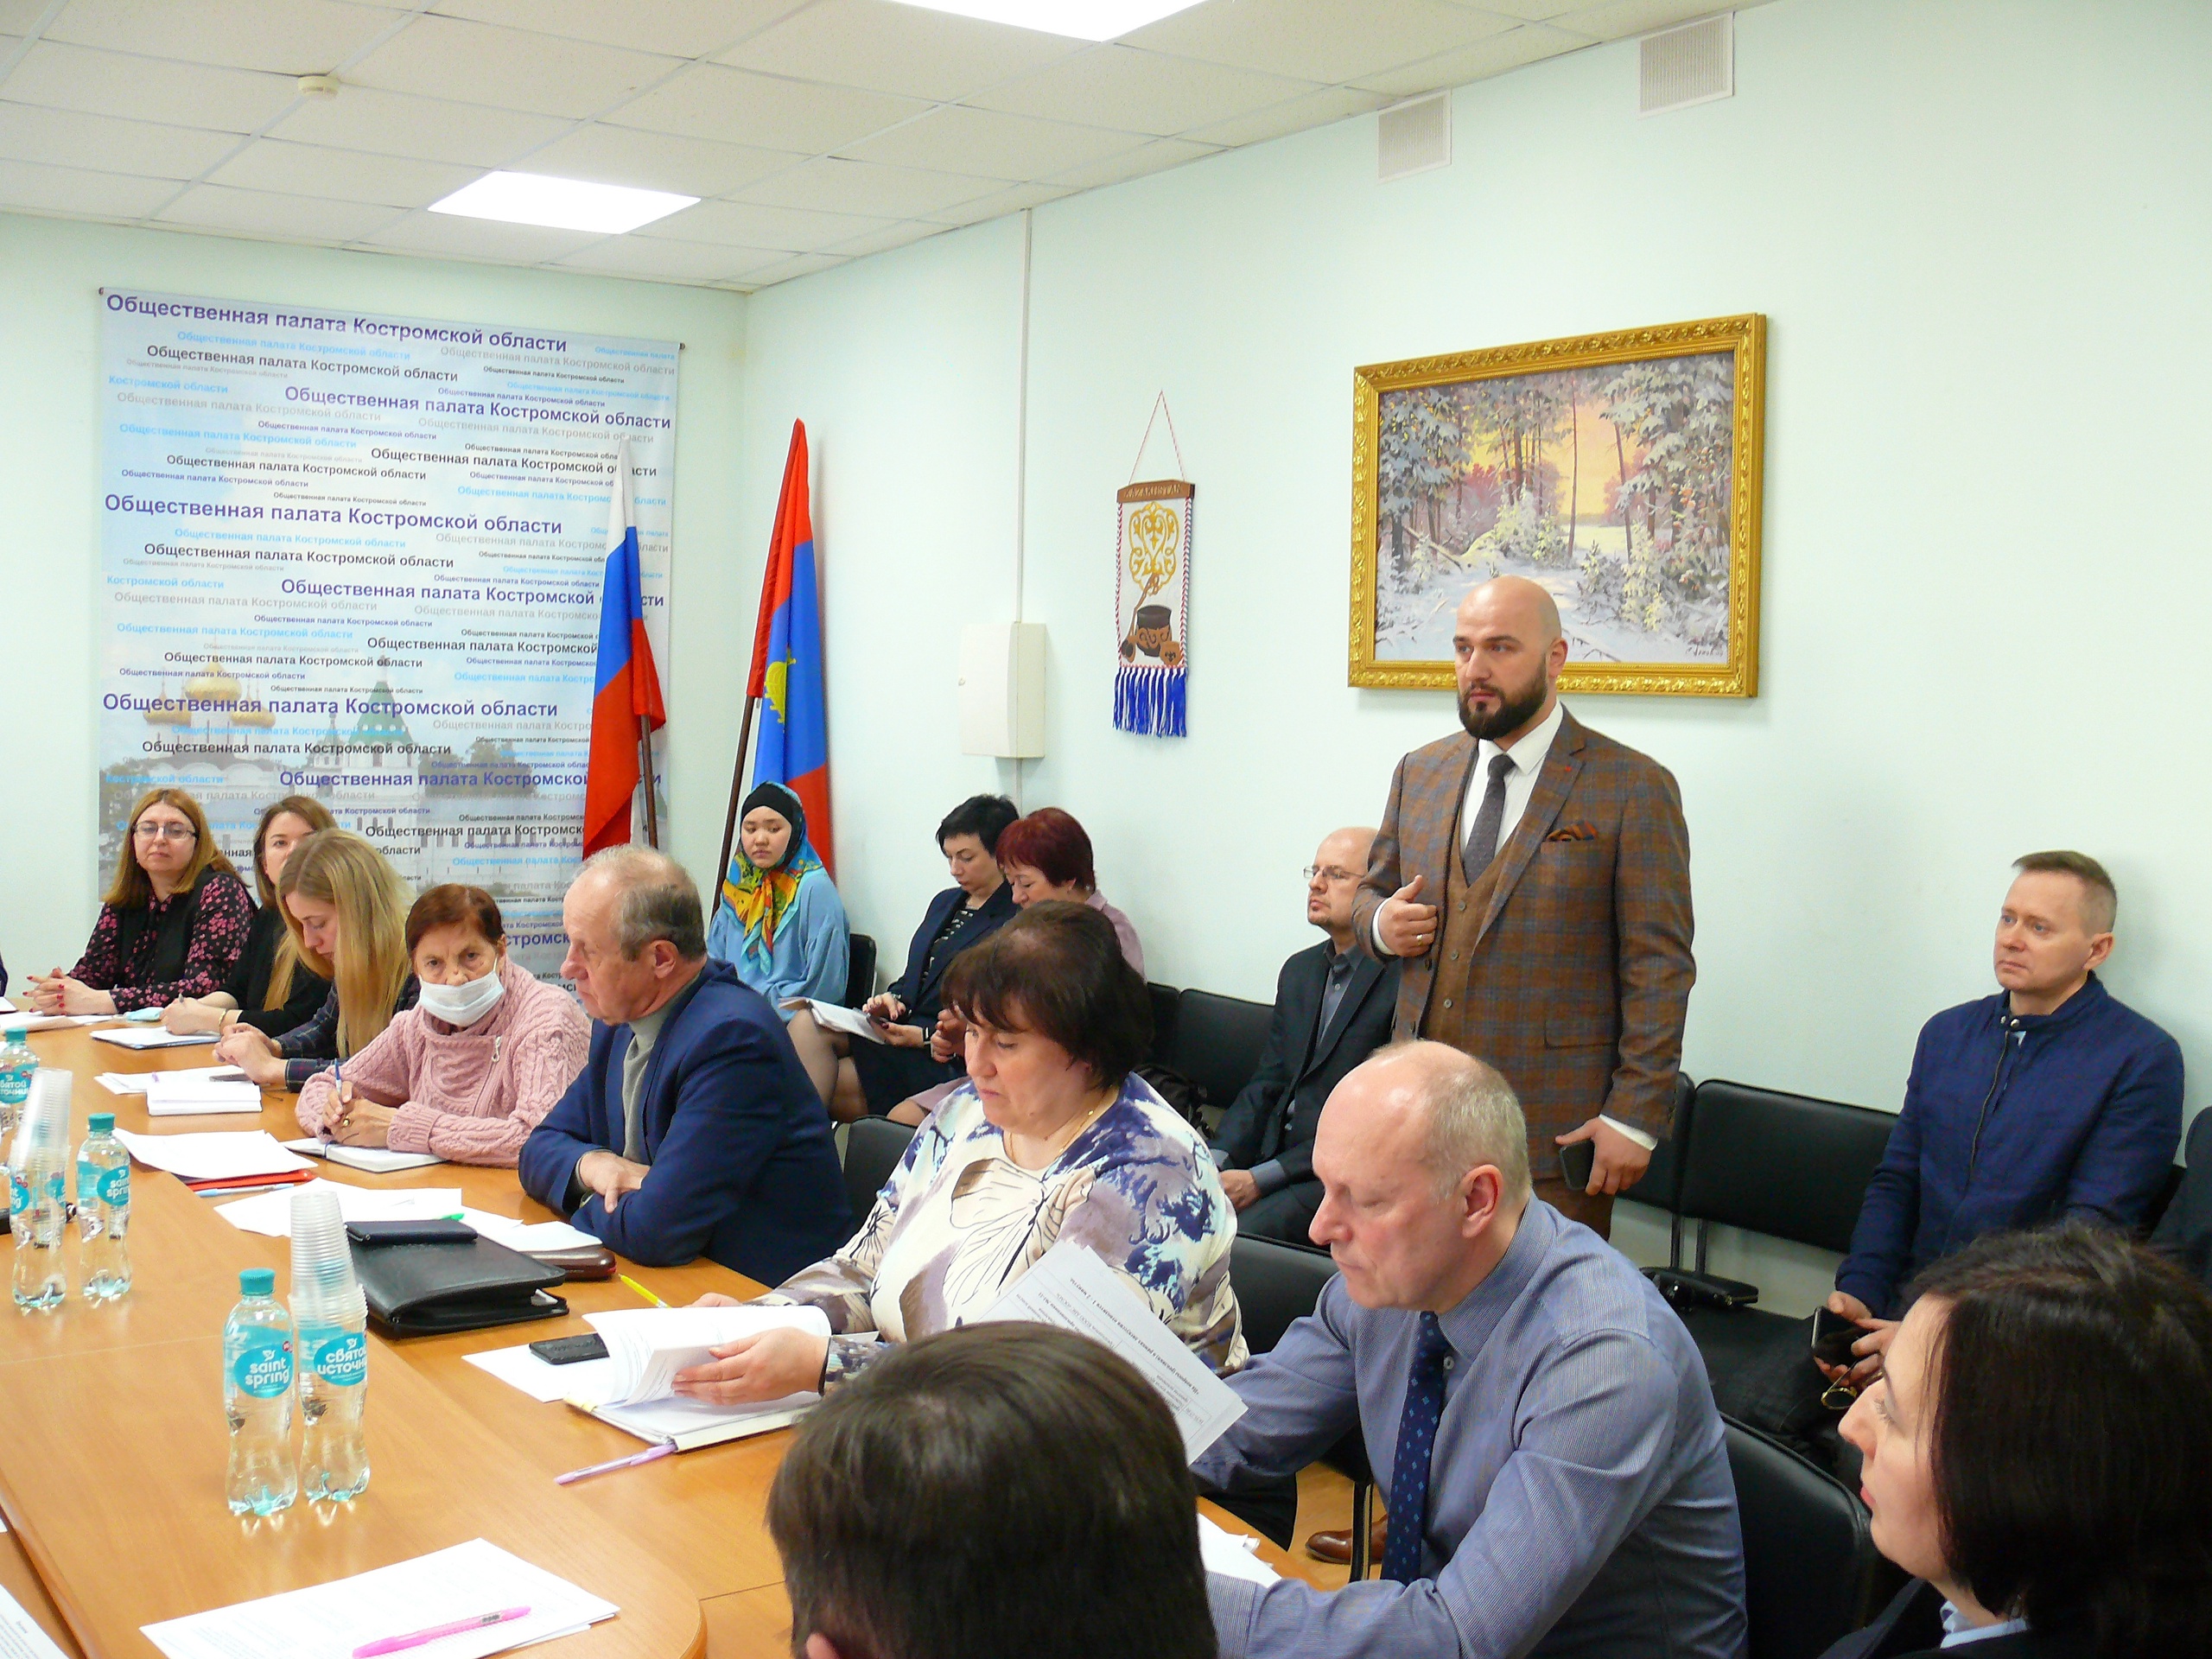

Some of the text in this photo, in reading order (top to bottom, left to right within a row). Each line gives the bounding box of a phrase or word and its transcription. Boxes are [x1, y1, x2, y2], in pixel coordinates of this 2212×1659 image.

[105, 294, 567, 353] Общественная палата Костромской области
[176, 330, 410, 360] Общественная палата Костромской области
[146, 345, 458, 382] Общественная палата Костромской области
[482, 365, 531, 376] Общественная
[556, 372, 597, 381] Костромской
[108, 374, 228, 393] Костромской области
[437, 387, 495, 398] Общественная
[524, 394, 573, 404] Костромской
[574, 398, 605, 407] области
[283, 386, 671, 429] Общественная палата Костромской области
[118, 423, 357, 448] Общественная палата Костромской области
[257, 420, 319, 431] Общественная
[350, 427, 403, 437] Костромской
[404, 430, 436, 440] области
[464, 442, 521, 453] Общественная
[550, 448, 599, 458] Костромской
[165, 454, 427, 480] Общественная палата Костромской области
[370, 448, 470, 464] Общественная
[472, 456, 518, 467] палата
[520, 458, 603, 473] Костромской
[121, 468, 185, 480] Общественная
[218, 474, 273, 486] Костромской
[274, 479, 308, 487] области
[469, 471, 526, 481] Общественная
[555, 476, 603, 486] Костромской
[457, 486, 666, 505] Общественная палата Костромс бласти
[104, 495, 563, 534] Общественная палата Костромской области
[173, 528, 406, 548] Общественная палата Костромской области
[143, 543, 454, 568] Общественная палата Костромской области
[478, 550, 527, 559] Общественная
[550, 554, 593, 563] Костромской
[105, 575, 225, 588] Костромской области
[433, 574, 491, 583] Общественная
[519, 577, 569, 587] Костромской
[280, 580, 595, 606] Общественная палата Костромской
[253, 614, 315, 623] Общественная
[346, 617, 398, 626] Костромской
[116, 622, 353, 639] Общественная палата Костромской области
[461, 628, 518, 637] Общественная
[545, 631, 594, 640] Костромской
[366, 637, 466, 651] Общественная
[468, 642, 514, 652] палата
[164, 652, 423, 667] Общественная палата Костромской области
[118, 668, 183, 677] Общественная
[215, 671, 270, 680] Костромской
[454, 671, 525, 683] Общественная
[101, 695, 559, 718] Общественная палата Костромской области
[141, 741, 451, 756] Общественная палата Костромской области
[278, 772, 413, 788] Общественная
[417, 775, 479, 785] палата
[344, 806, 397, 816] Костромской
[458, 814, 514, 823] Общественная
[365, 826, 463, 838] Общественная
[250, 1357, 287, 1374] saint
[245, 1367, 290, 1389] spring
